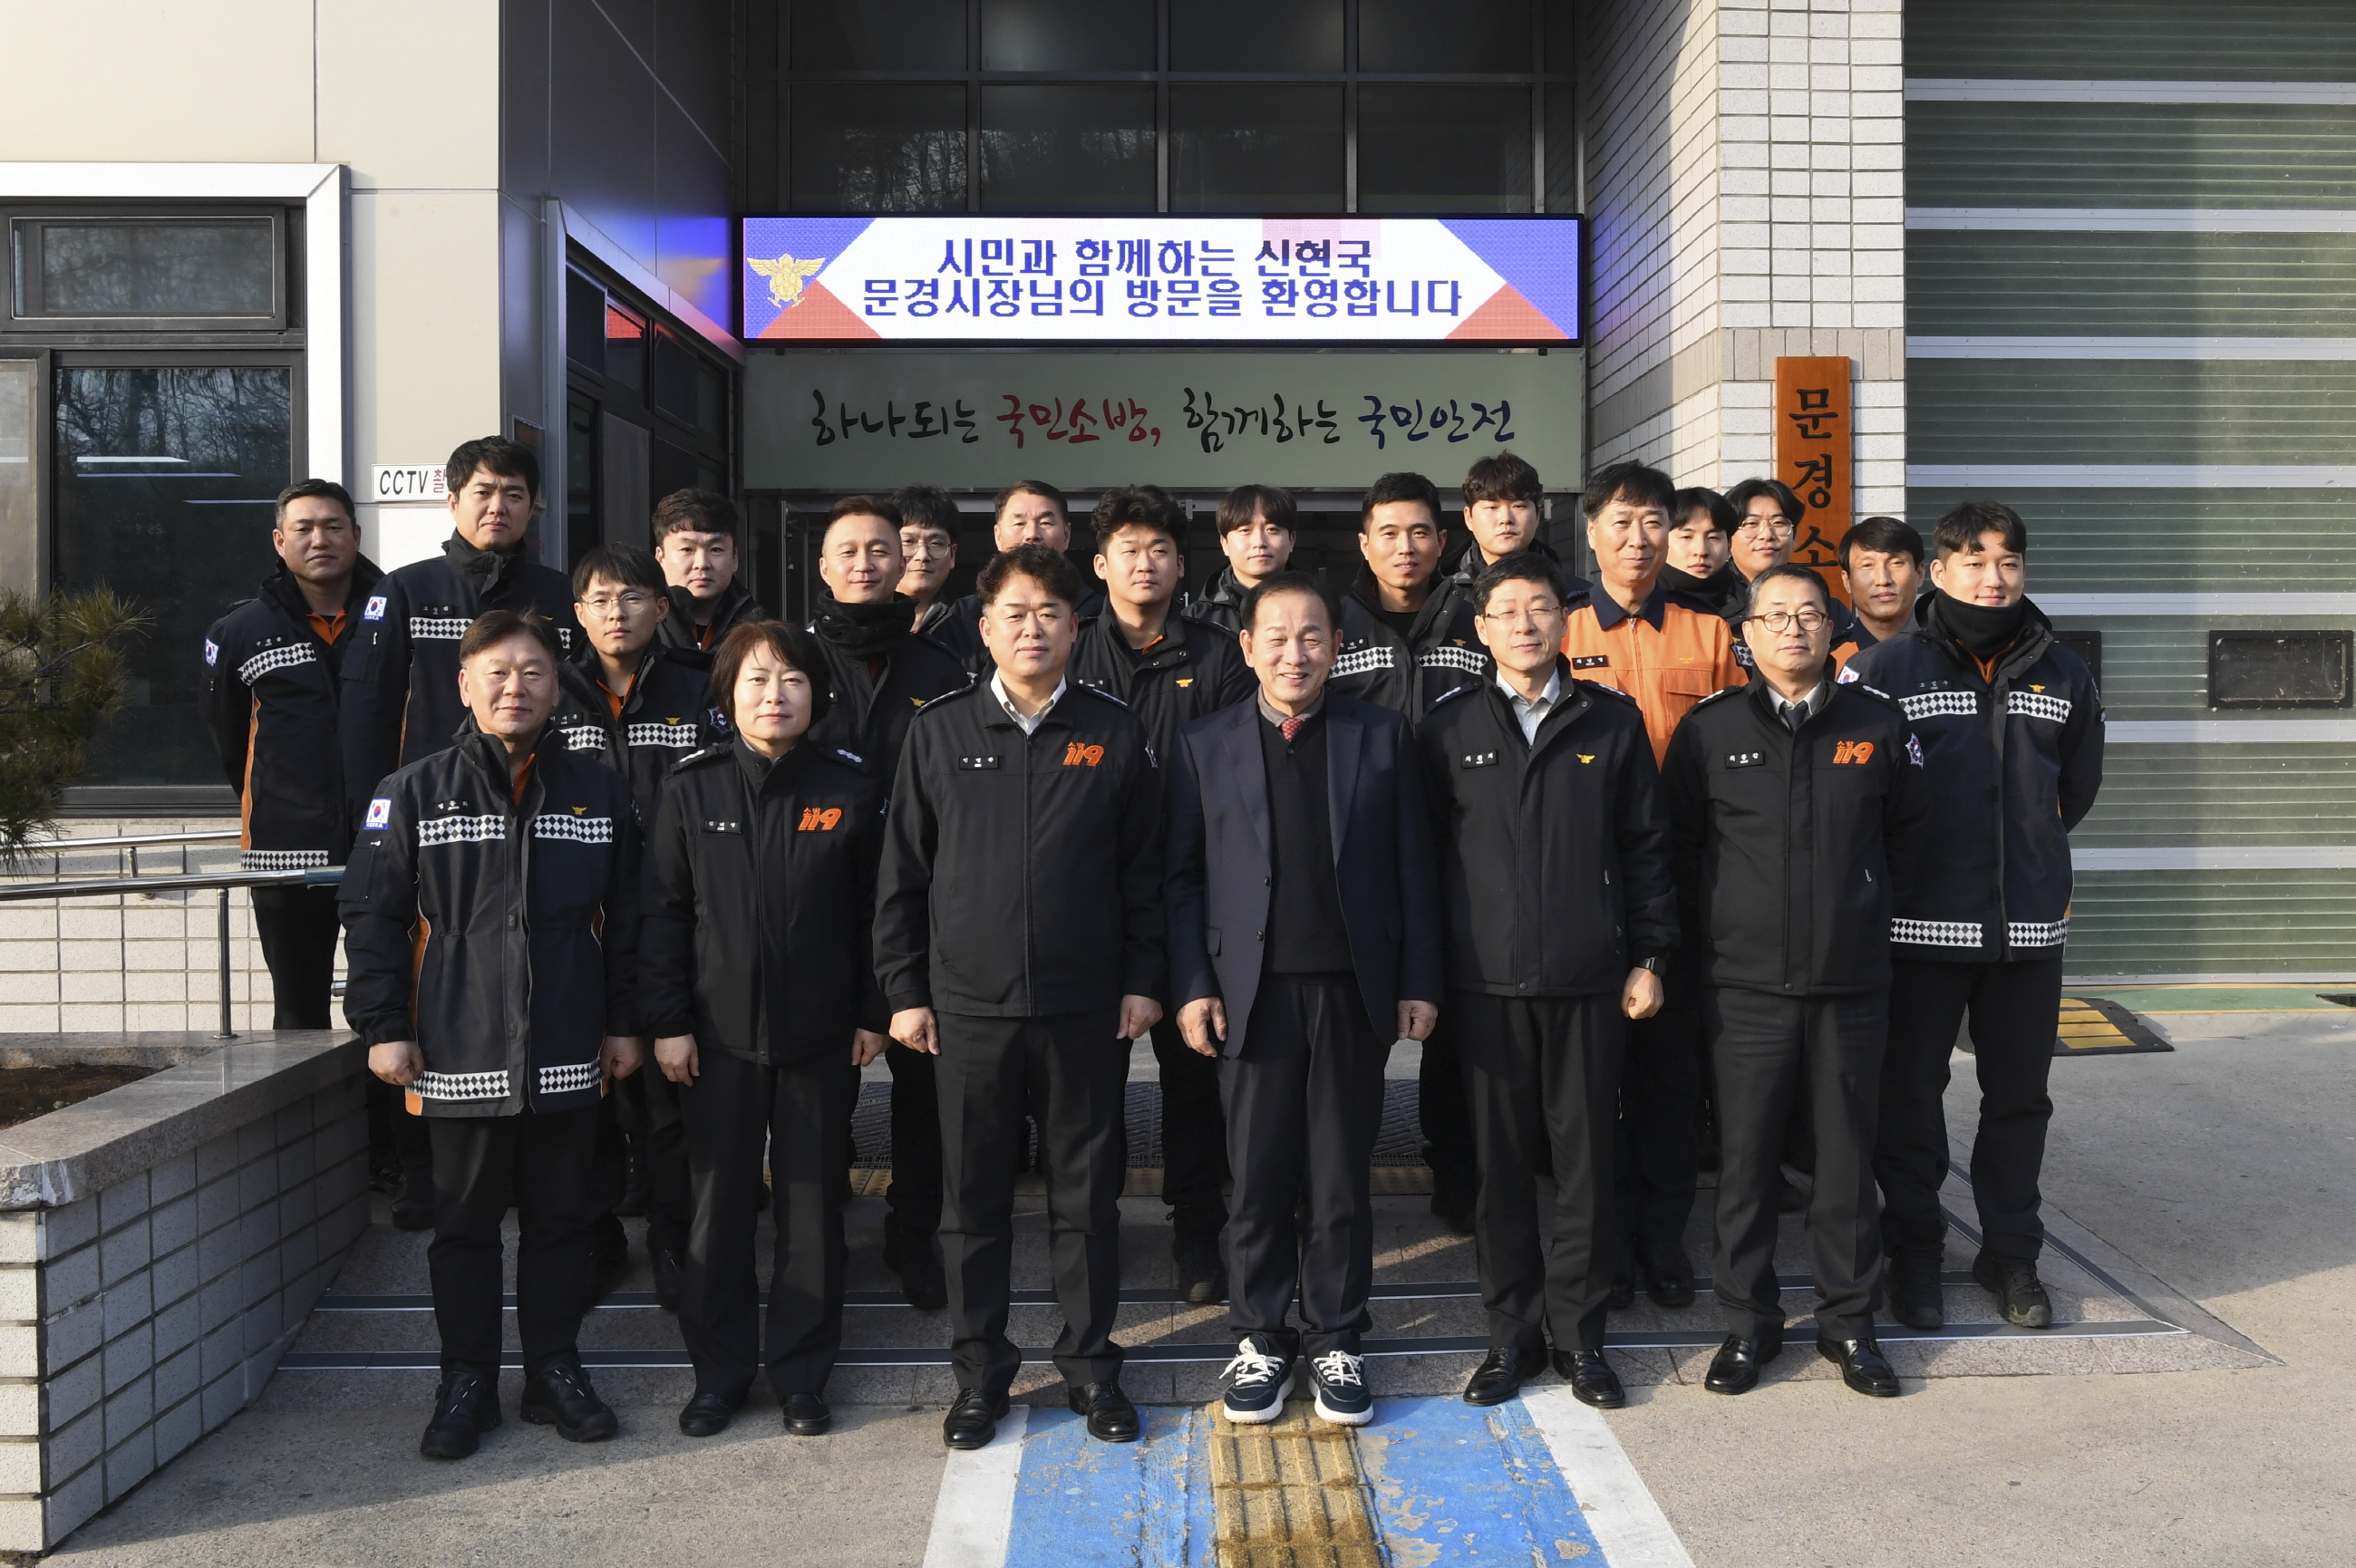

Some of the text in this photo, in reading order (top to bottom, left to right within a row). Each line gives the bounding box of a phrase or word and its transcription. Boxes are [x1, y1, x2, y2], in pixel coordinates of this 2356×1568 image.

[937, 238, 1371, 277] 시민과 함께하는 신현국
[864, 278, 1462, 317] 문경시장님의 방문을 환영합니다
[812, 387, 1515, 453] 하나되는 국민소방, 함께하는 국민안전
[379, 469, 429, 495] CCTV
[1062, 744, 1105, 767] 119
[1832, 741, 1875, 765] 119
[1837, 740, 1855, 749] 소방
[798, 808, 842, 831] 119
